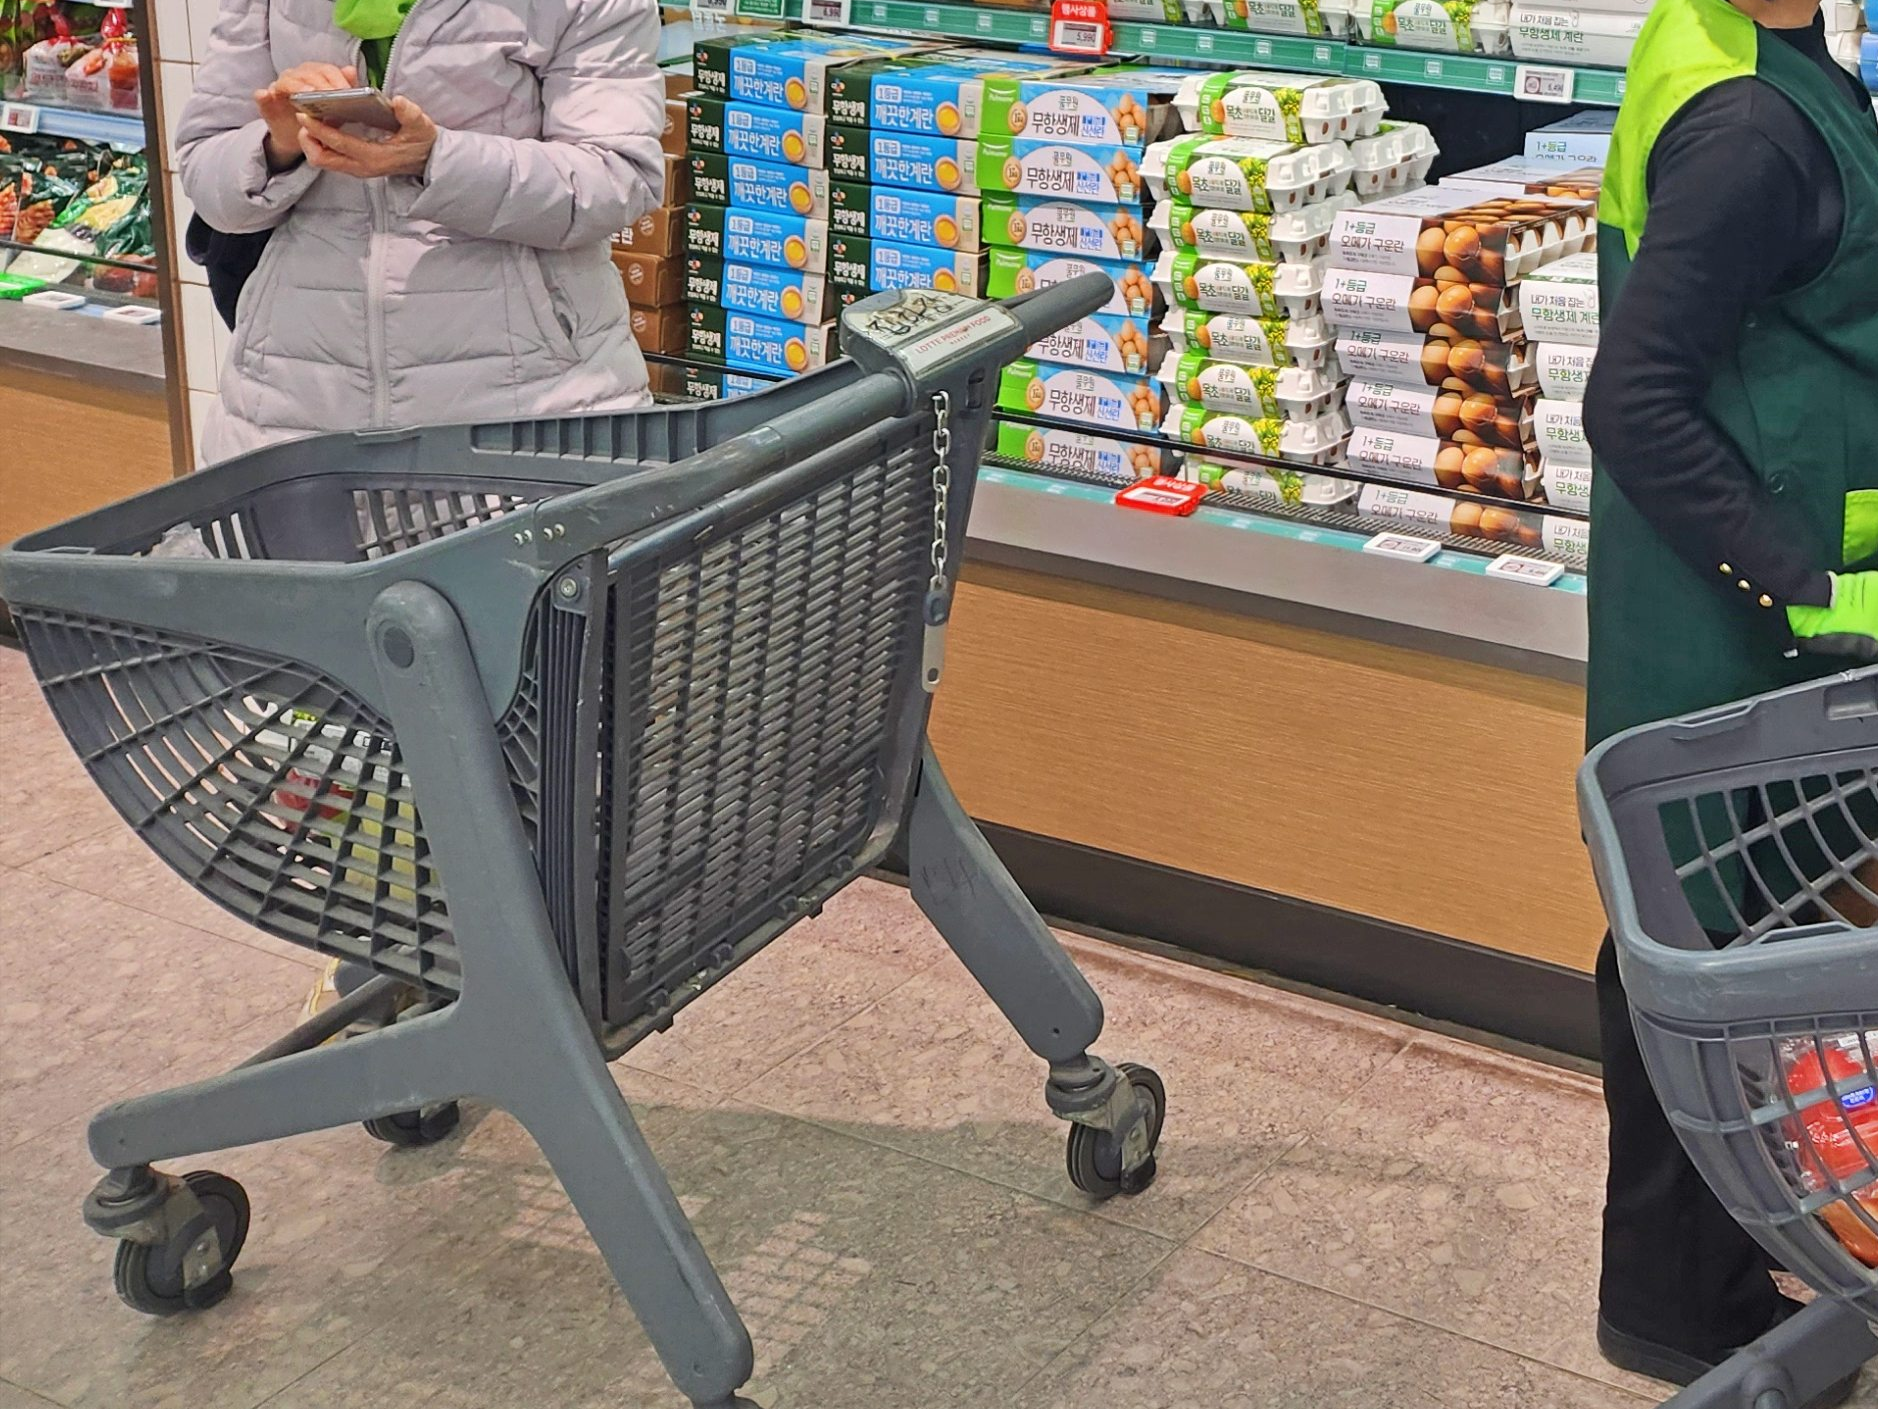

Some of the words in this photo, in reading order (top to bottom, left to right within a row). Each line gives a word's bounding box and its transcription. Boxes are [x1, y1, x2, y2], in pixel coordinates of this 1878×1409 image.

[698, 69, 725, 86] 무항생제
[734, 76, 784, 103] 깨끗한계란
[832, 100, 865, 118] 무항생제
[875, 103, 933, 130] 깨끗한계란
[1226, 103, 1243, 120] 목초
[1258, 106, 1276, 123] 달걀
[1032, 112, 1080, 137] 무항생제
[875, 157, 933, 184] 깨끗한계란
[1027, 167, 1074, 192] 무항생제
[1344, 220, 1376, 234] 1+등급
[1341, 235, 1371, 249] 오메가
[1373, 237, 1404, 252] 구운란
[1335, 278, 1367, 293] 1+등급
[726, 283, 780, 311] 깨끗한계란
[1332, 293, 1363, 306] 오메가
[1365, 295, 1396, 311] 구운란
[1532, 308, 1577, 323] 무항생제
[916, 336, 943, 354] LOTTE
[1048, 389, 1096, 417] 무항생제
